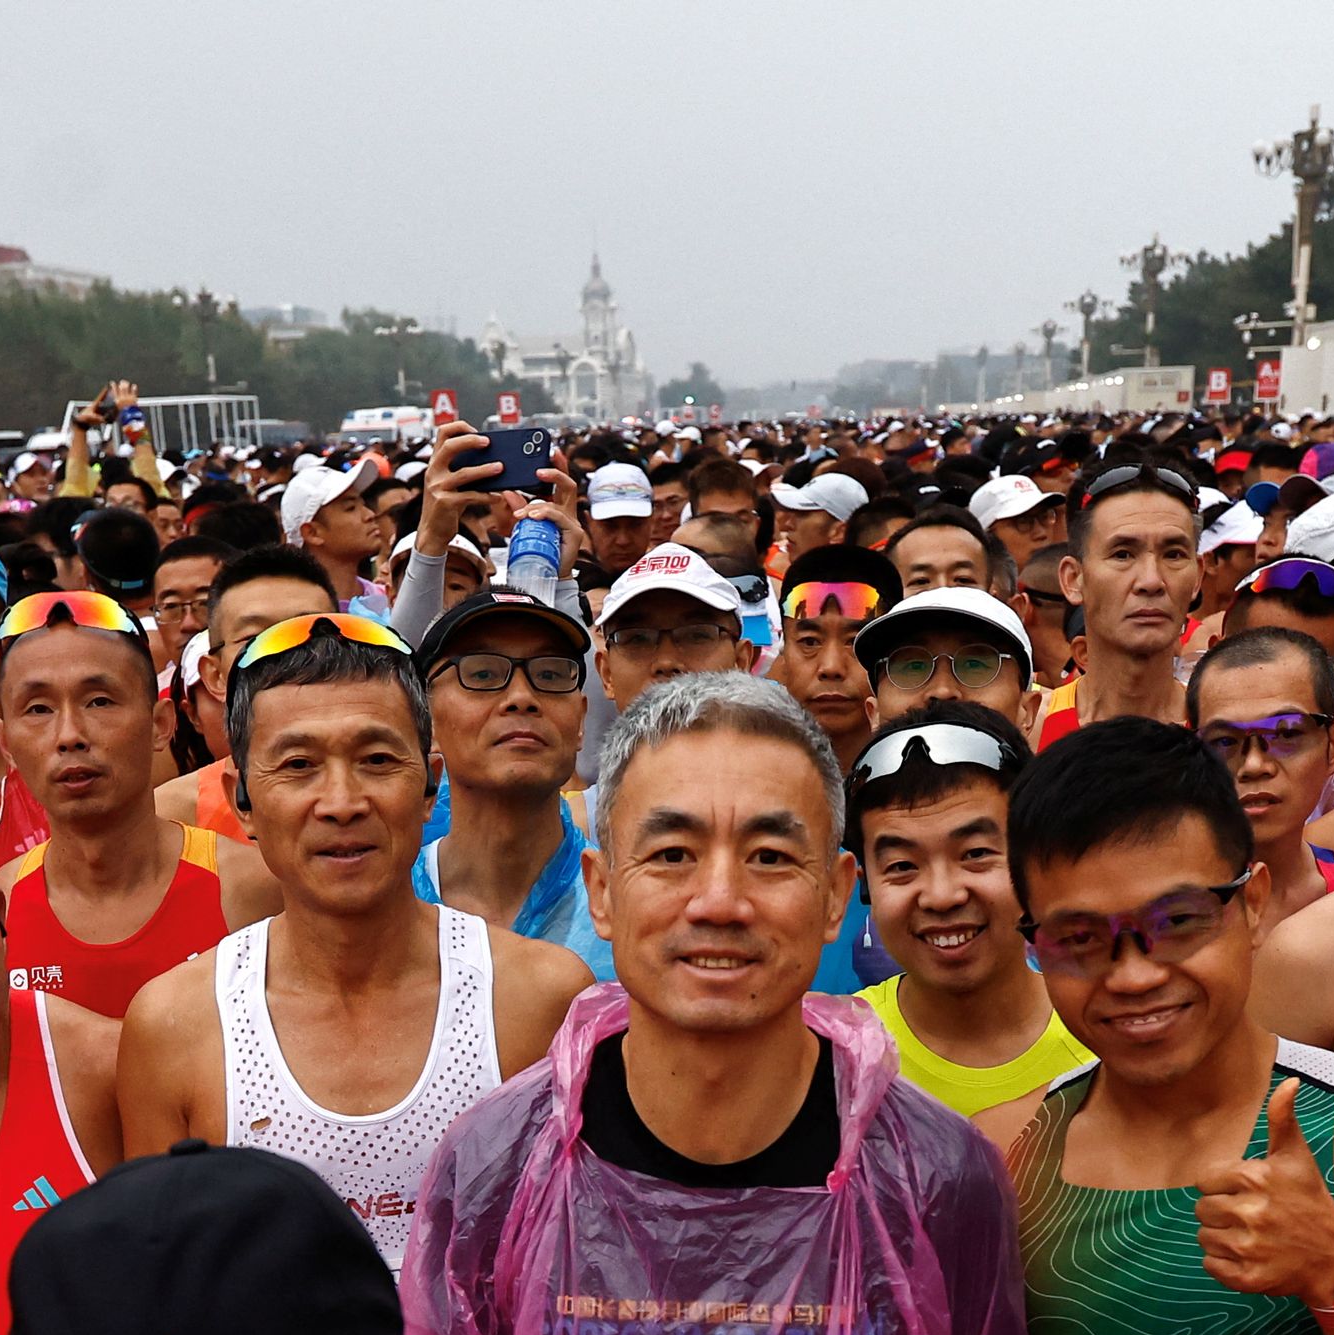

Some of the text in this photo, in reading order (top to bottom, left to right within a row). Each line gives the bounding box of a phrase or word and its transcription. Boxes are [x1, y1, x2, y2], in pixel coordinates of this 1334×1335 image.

[1210, 370, 1228, 391] B
[434, 392, 454, 415] A
[499, 395, 518, 415] B
[31, 965, 63, 985] 贝壳
